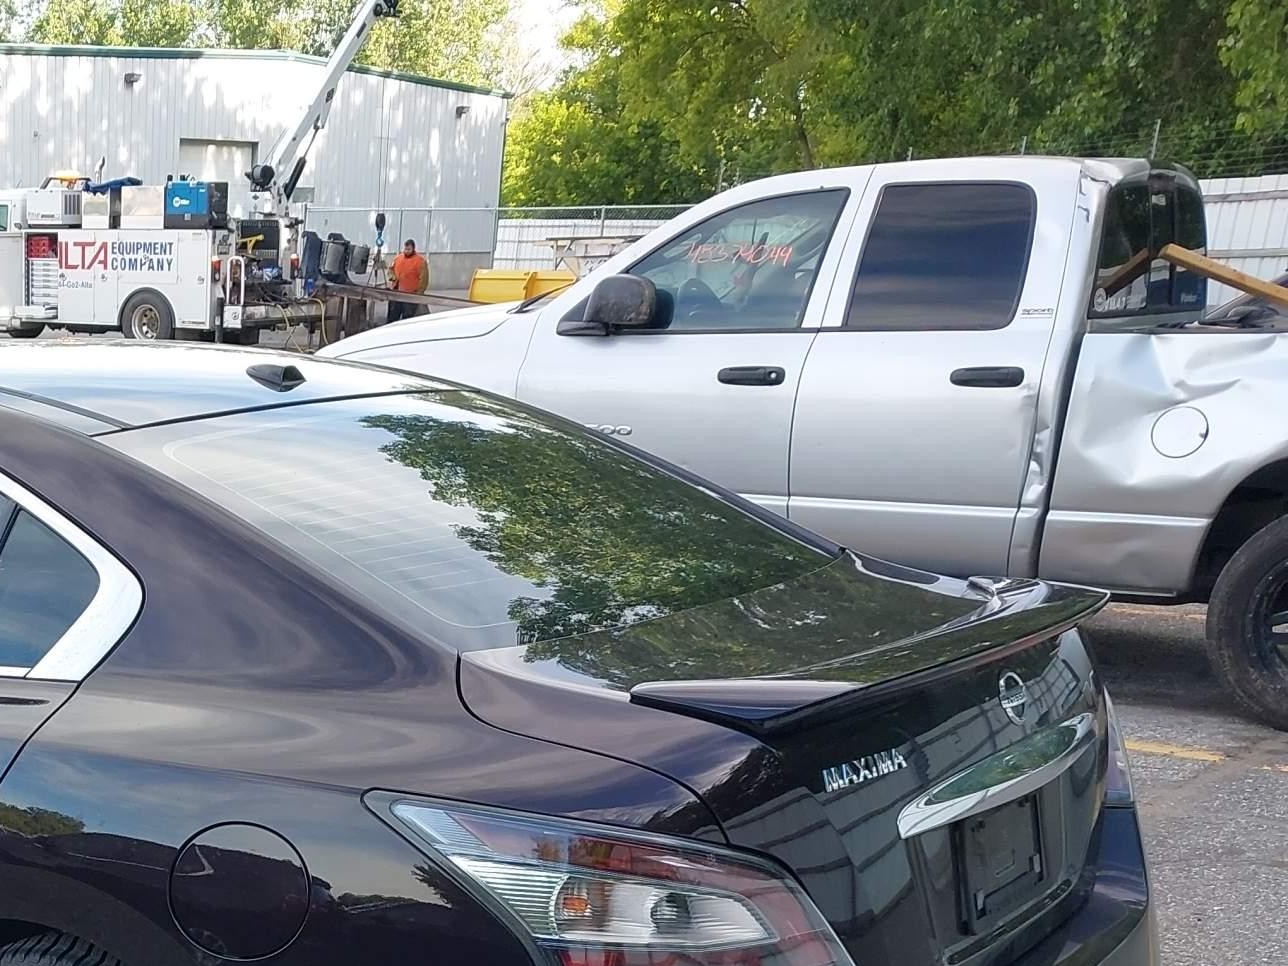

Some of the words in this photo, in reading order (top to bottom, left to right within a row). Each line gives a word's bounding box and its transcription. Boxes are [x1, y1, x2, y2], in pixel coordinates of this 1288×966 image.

[111, 242, 174, 256] EQUIPMENT
[111, 257, 174, 271] COMPANY
[822, 748, 908, 793] MAXIMA
